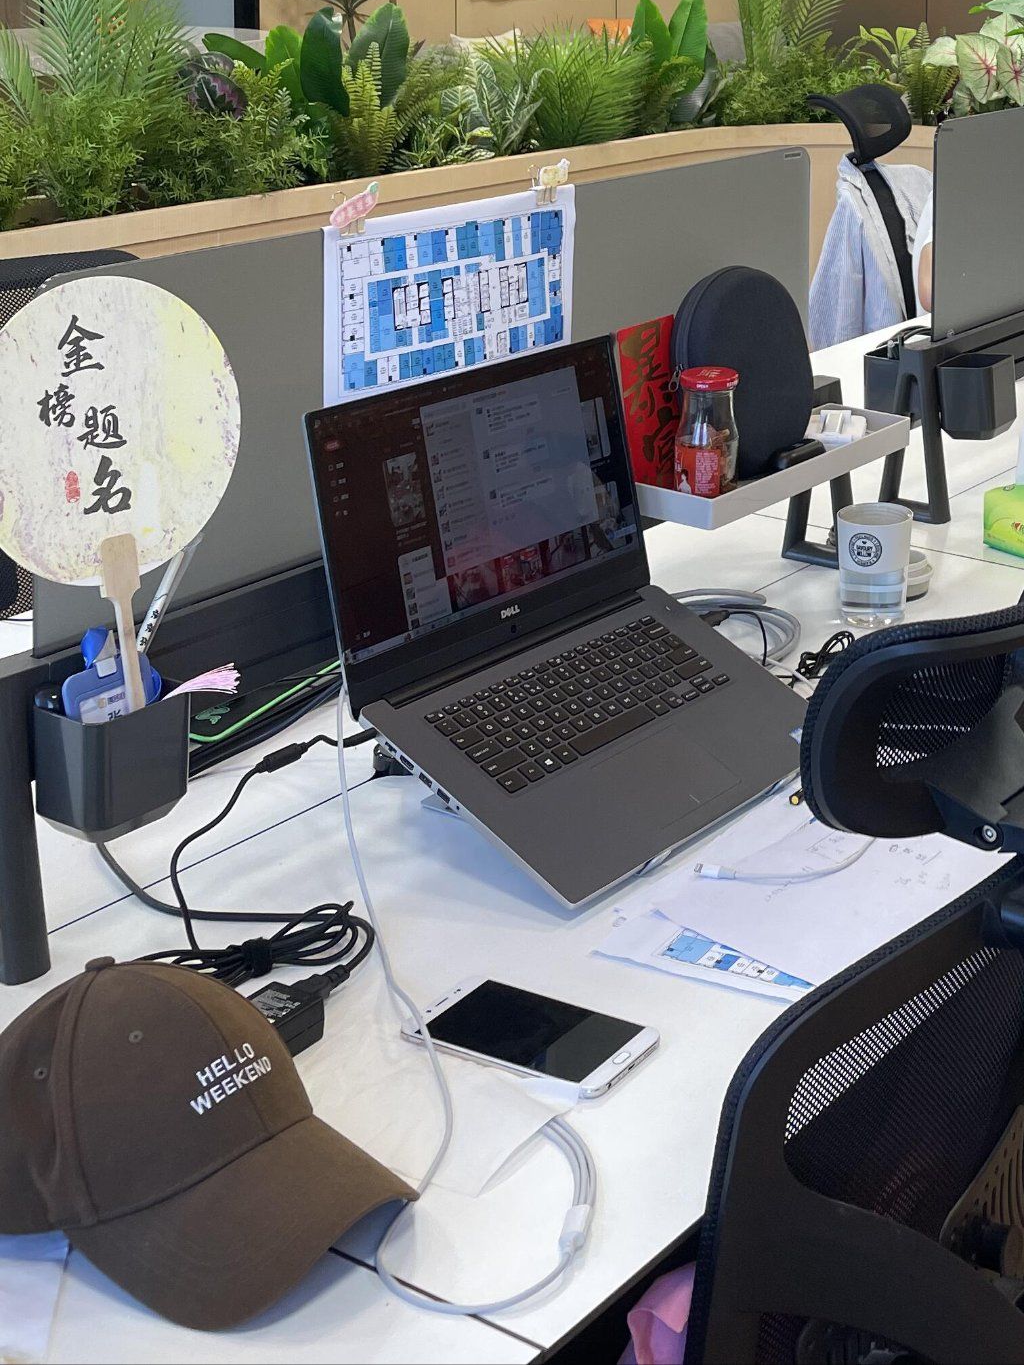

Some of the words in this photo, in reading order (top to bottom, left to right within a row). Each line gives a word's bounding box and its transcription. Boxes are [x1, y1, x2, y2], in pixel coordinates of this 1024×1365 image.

[37, 315, 132, 515] 金榜题名
[501, 604, 520, 619] DELL
[189, 1056, 272, 1115] WEEKEND
[195, 1042, 255, 1087] HELLO
